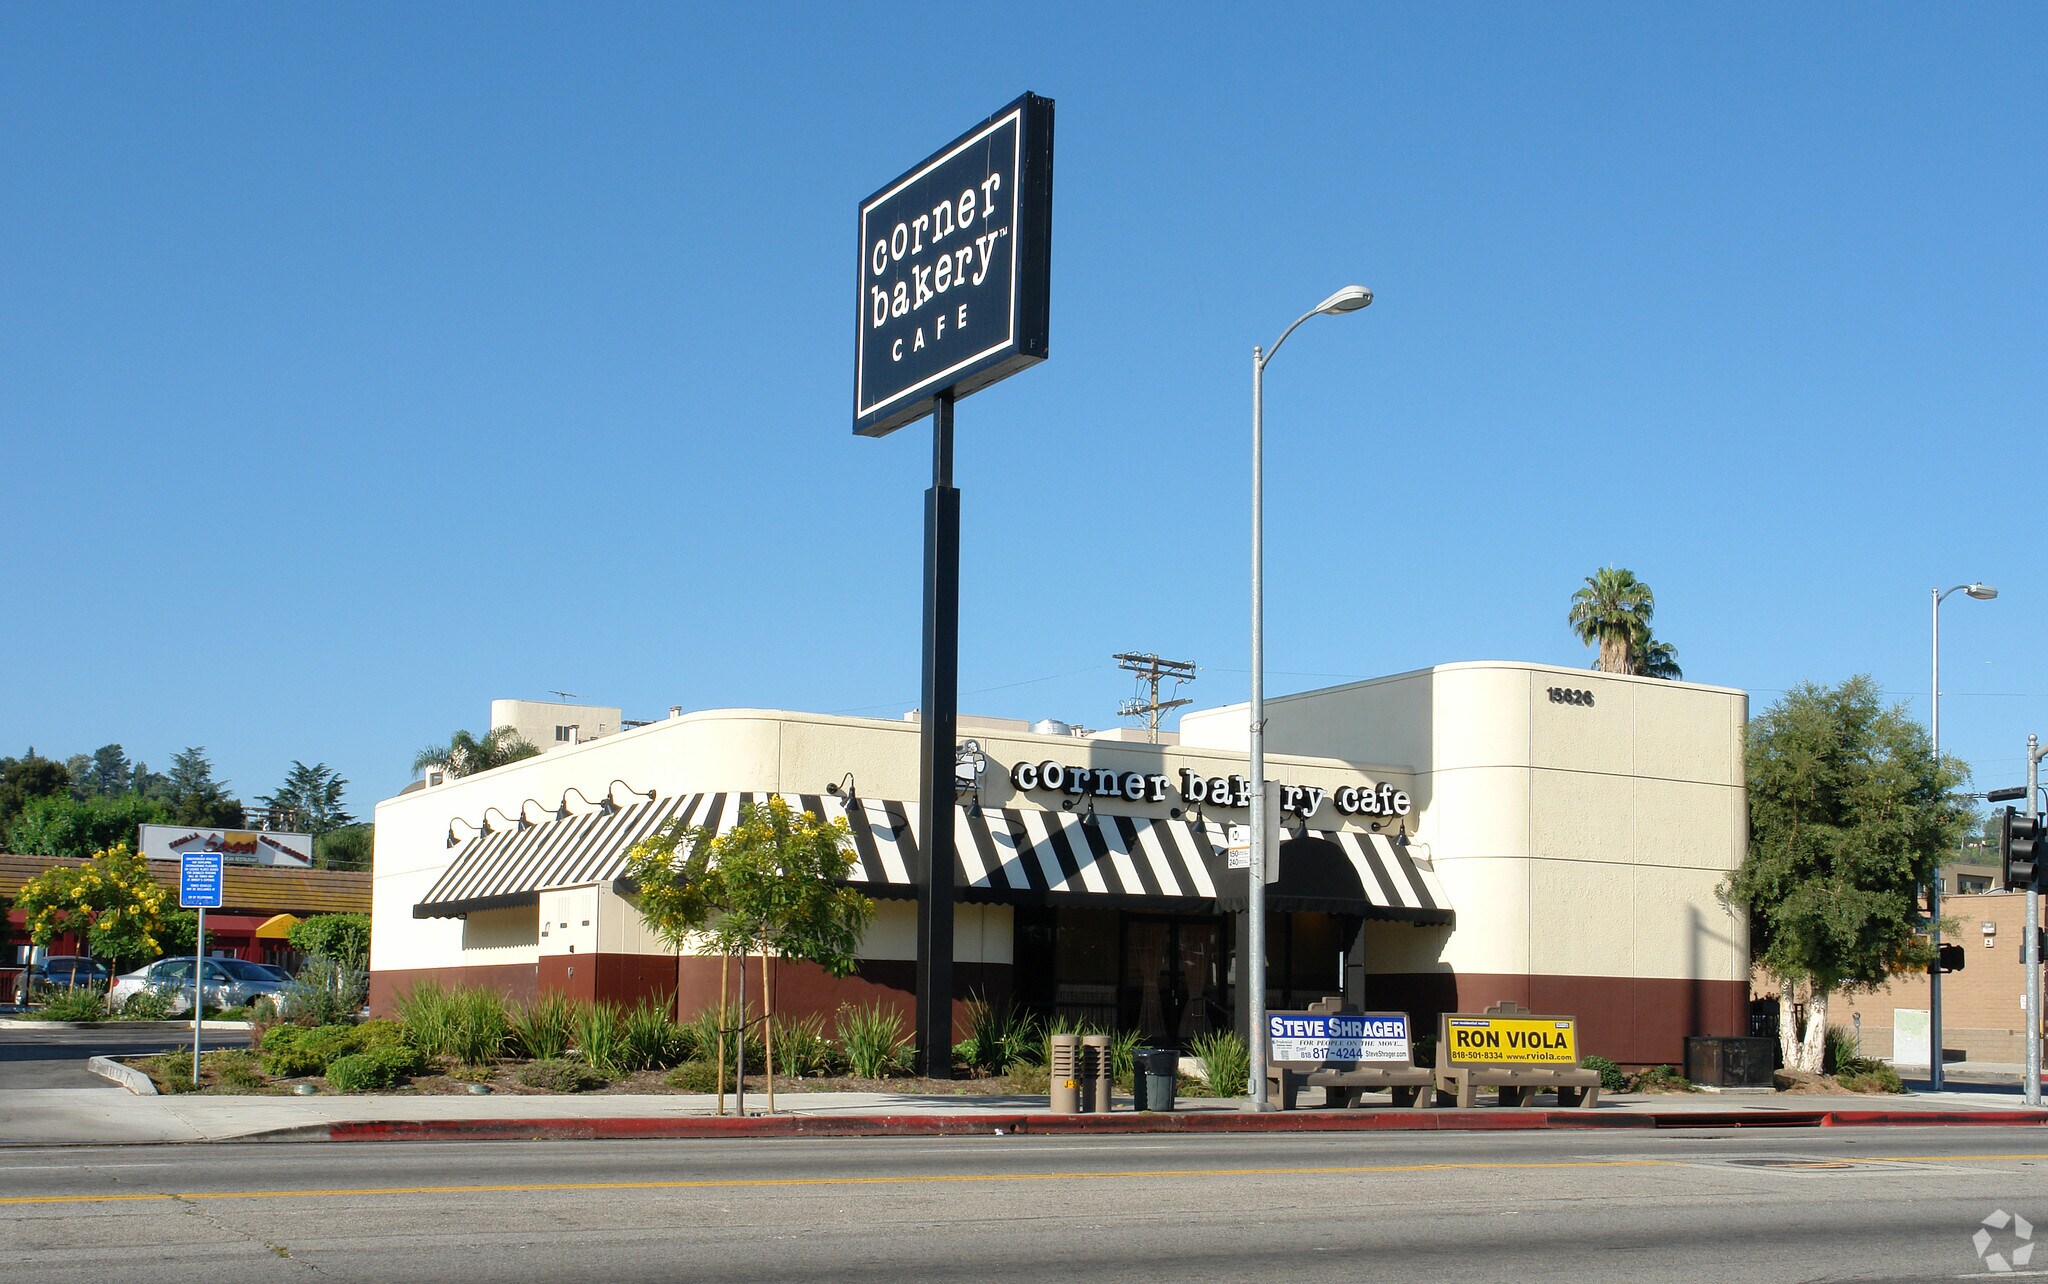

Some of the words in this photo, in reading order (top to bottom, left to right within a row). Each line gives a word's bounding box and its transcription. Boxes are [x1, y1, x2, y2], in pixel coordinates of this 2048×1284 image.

[872, 171, 1001, 276] corner
[871, 229, 1000, 329] bakery
[891, 303, 968, 362] CAFE
[1546, 687, 1595, 706] 15626
[1014, 760, 1171, 802] corner
[1184, 768, 1328, 818] bakry
[1340, 783, 1412, 815] cafe
[1270, 1017, 1325, 1037] STEVE
[1328, 1018, 1405, 1037] SHRAGER
[1457, 1030, 1500, 1048] RON
[1506, 1031, 1568, 1049] VIOLA
[1300, 1051, 1312, 1059] 818
[1312, 1047, 1363, 1059] 817-4244
[1365, 1050, 1407, 1059] SteveShrager.com
[1506, 1052, 1572, 1061] www.rviola.com
